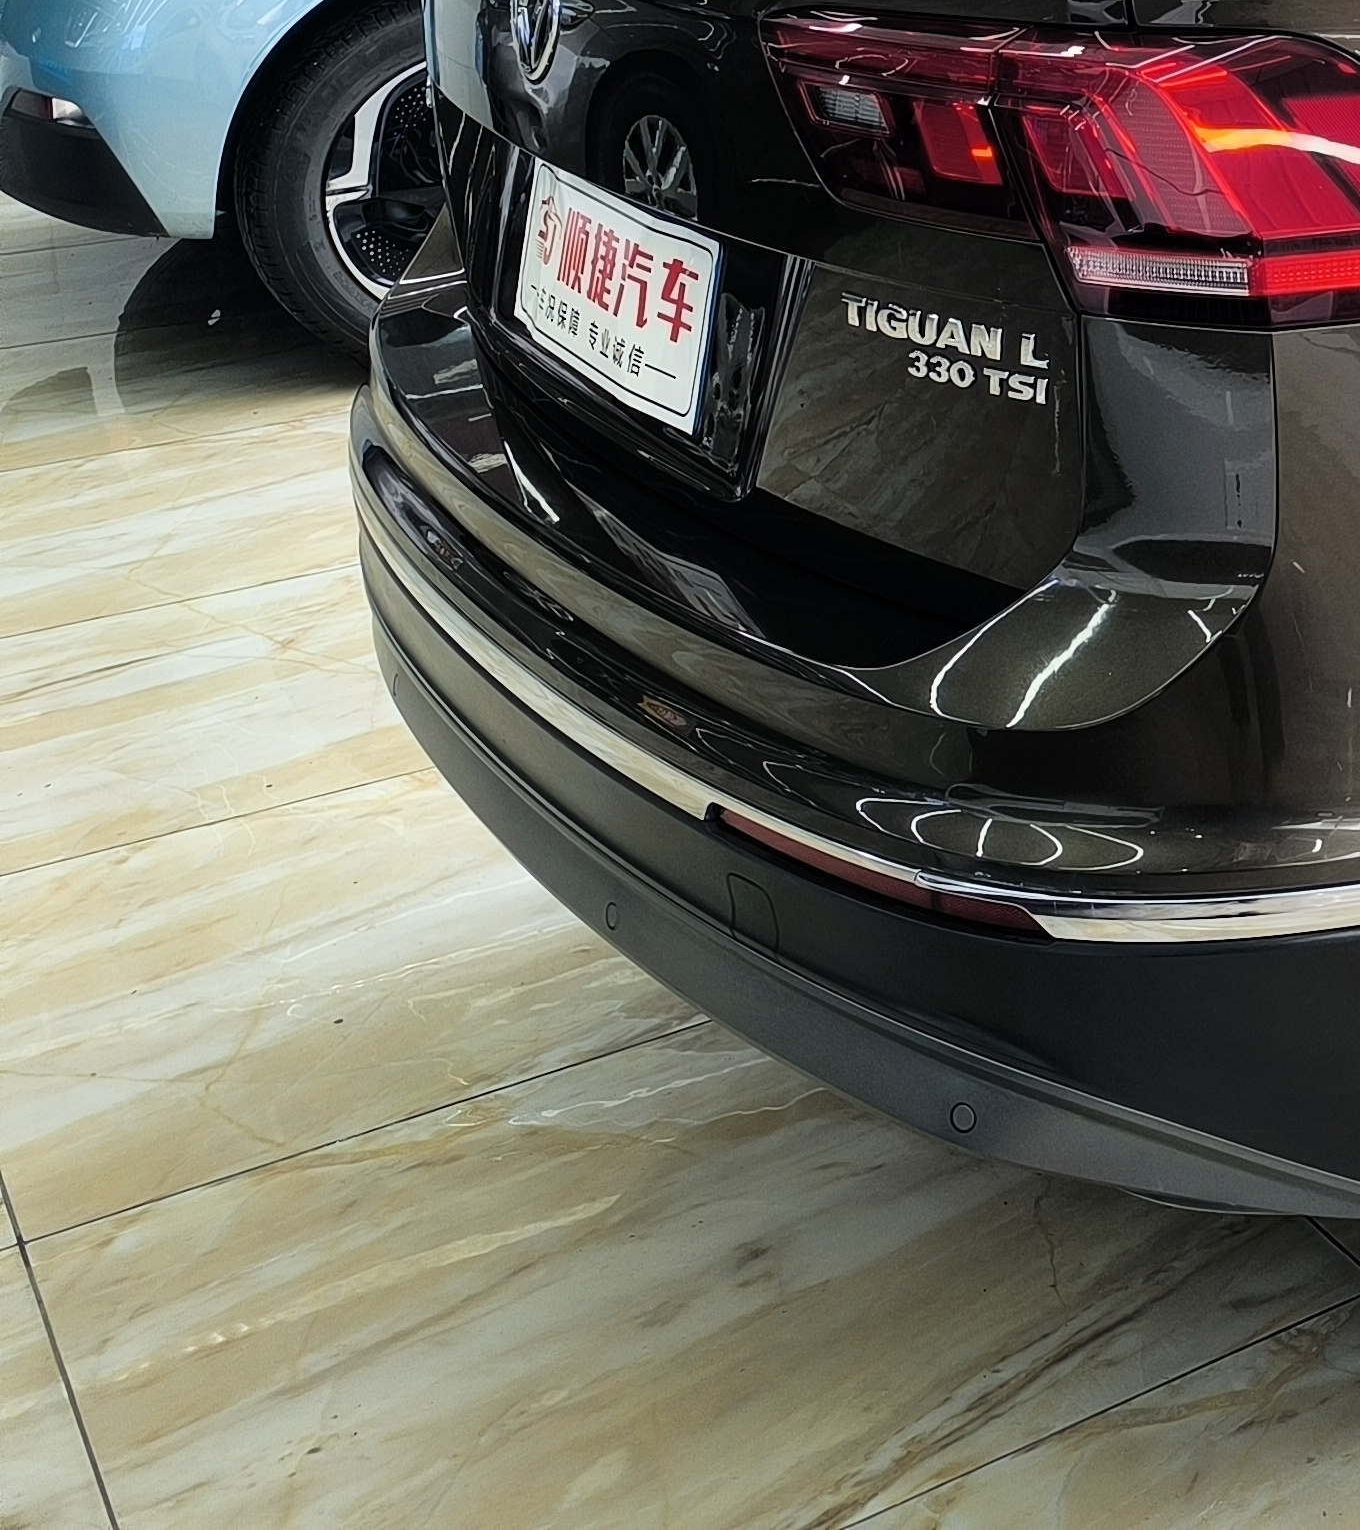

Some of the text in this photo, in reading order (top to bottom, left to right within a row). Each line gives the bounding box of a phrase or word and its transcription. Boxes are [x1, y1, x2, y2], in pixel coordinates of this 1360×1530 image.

[557, 207, 700, 343] 顺捷汽车
[588, 320, 645, 377] 专业诚信
[841, 292, 1050, 369] TIGUAN L
[906, 349, 1049, 405] 330 TSI
